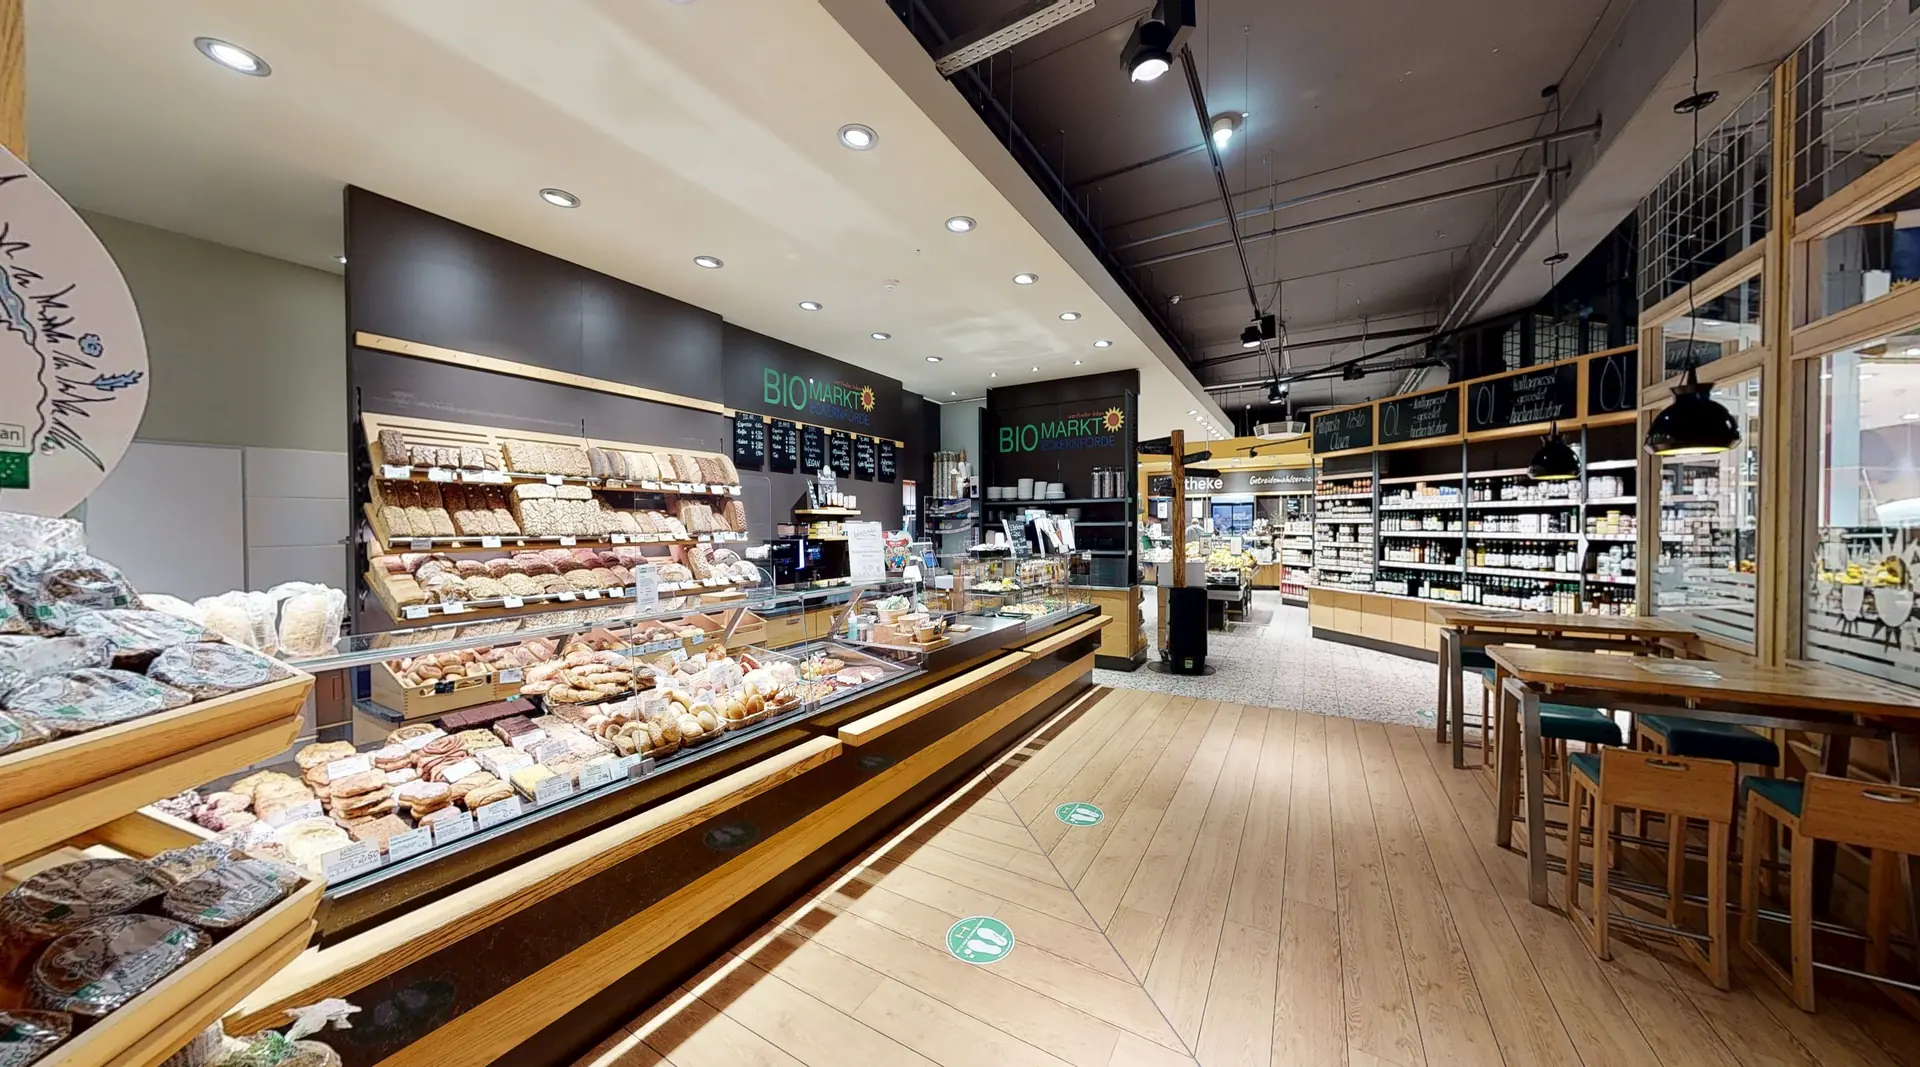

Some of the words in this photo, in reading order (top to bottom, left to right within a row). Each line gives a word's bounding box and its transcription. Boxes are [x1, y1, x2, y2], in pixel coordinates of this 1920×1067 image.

[764, 368, 807, 411] BIO
[809, 379, 861, 410] MARKT
[0, 430, 19, 440] an
[1000, 424, 1039, 453] BIO
[1041, 417, 1103, 439] MARKT
[805, 458, 820, 468] VEGAN
